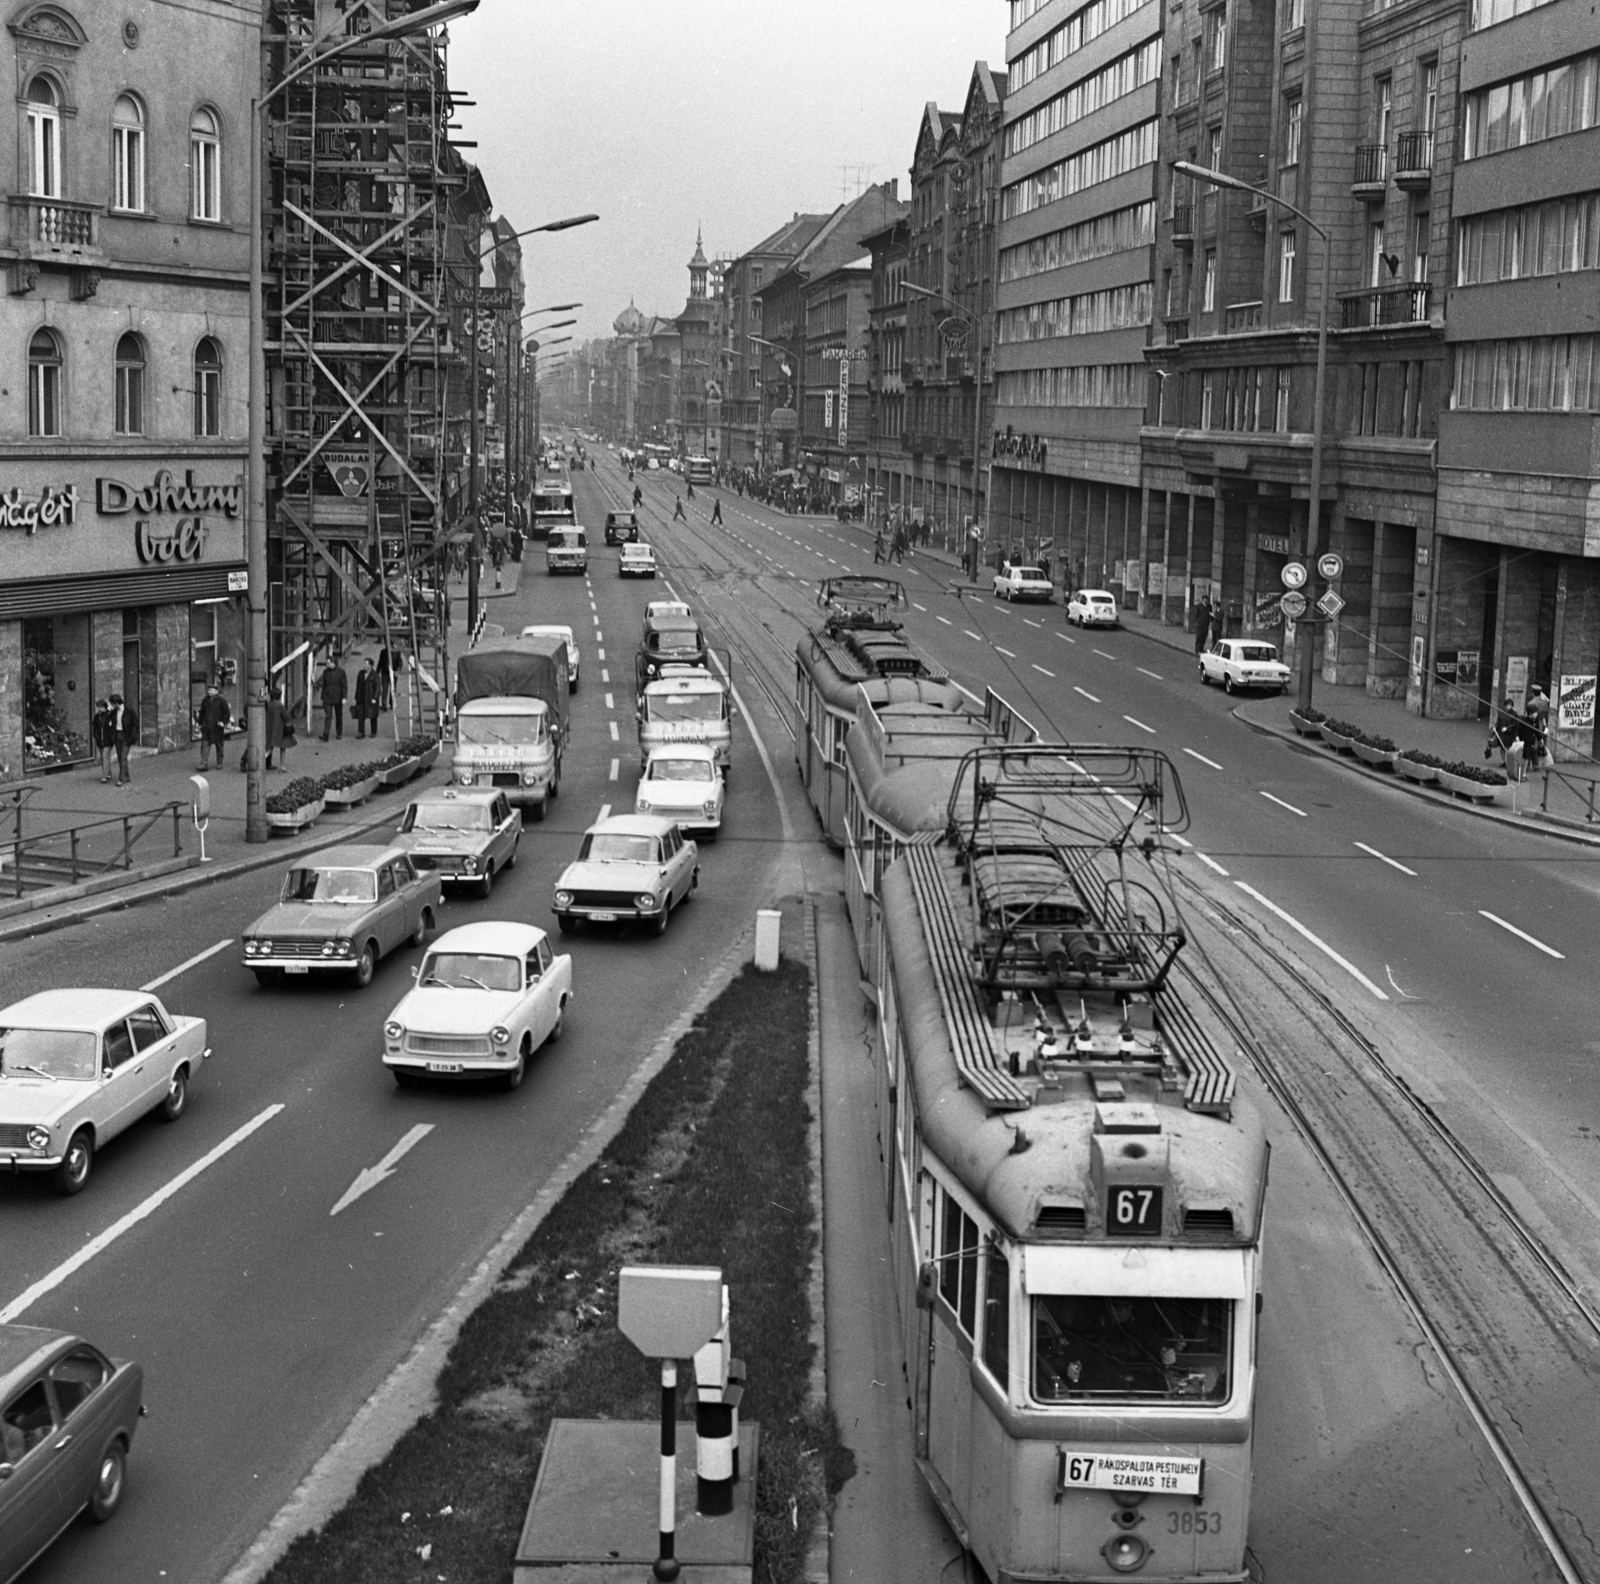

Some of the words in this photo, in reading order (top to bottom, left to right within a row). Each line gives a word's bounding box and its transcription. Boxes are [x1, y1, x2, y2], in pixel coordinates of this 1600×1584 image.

[135, 517, 209, 564] bolt
[1257, 534, 1288, 553] HOTEL
[1117, 1189, 1153, 1224] 67
[1069, 1458, 1095, 1482] 67
[1098, 1457, 1155, 1473] RÁKOSPALOTA
[1113, 1474, 1155, 1488] SZARVAS
[1161, 1475, 1178, 1489] TÉR
[1167, 1511, 1222, 1535] 3853
